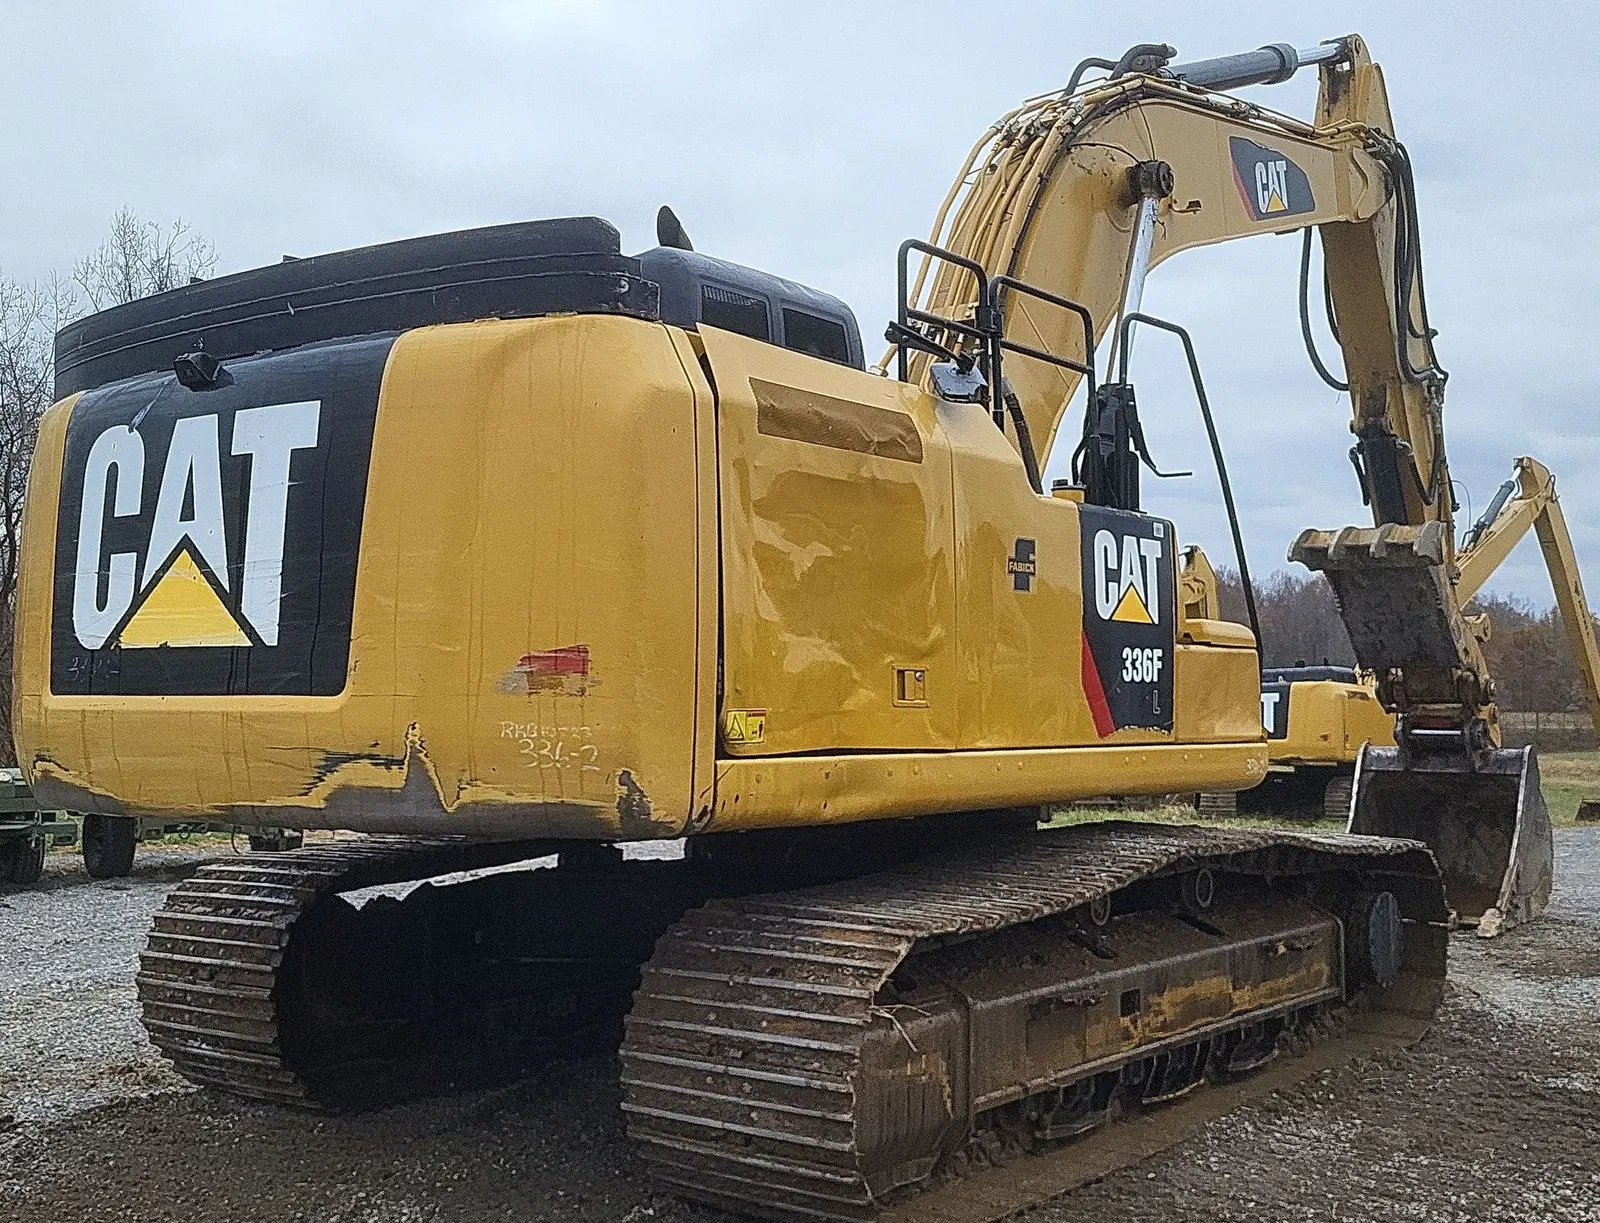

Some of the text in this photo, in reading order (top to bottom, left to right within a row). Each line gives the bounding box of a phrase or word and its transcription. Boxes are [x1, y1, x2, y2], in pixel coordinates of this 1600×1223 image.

[1255, 160, 1288, 213] CAT
[73, 400, 321, 649] CAT
[1009, 561, 1035, 573] FABICK
[1094, 529, 1161, 624] CAT
[1122, 647, 1163, 683] 336F
